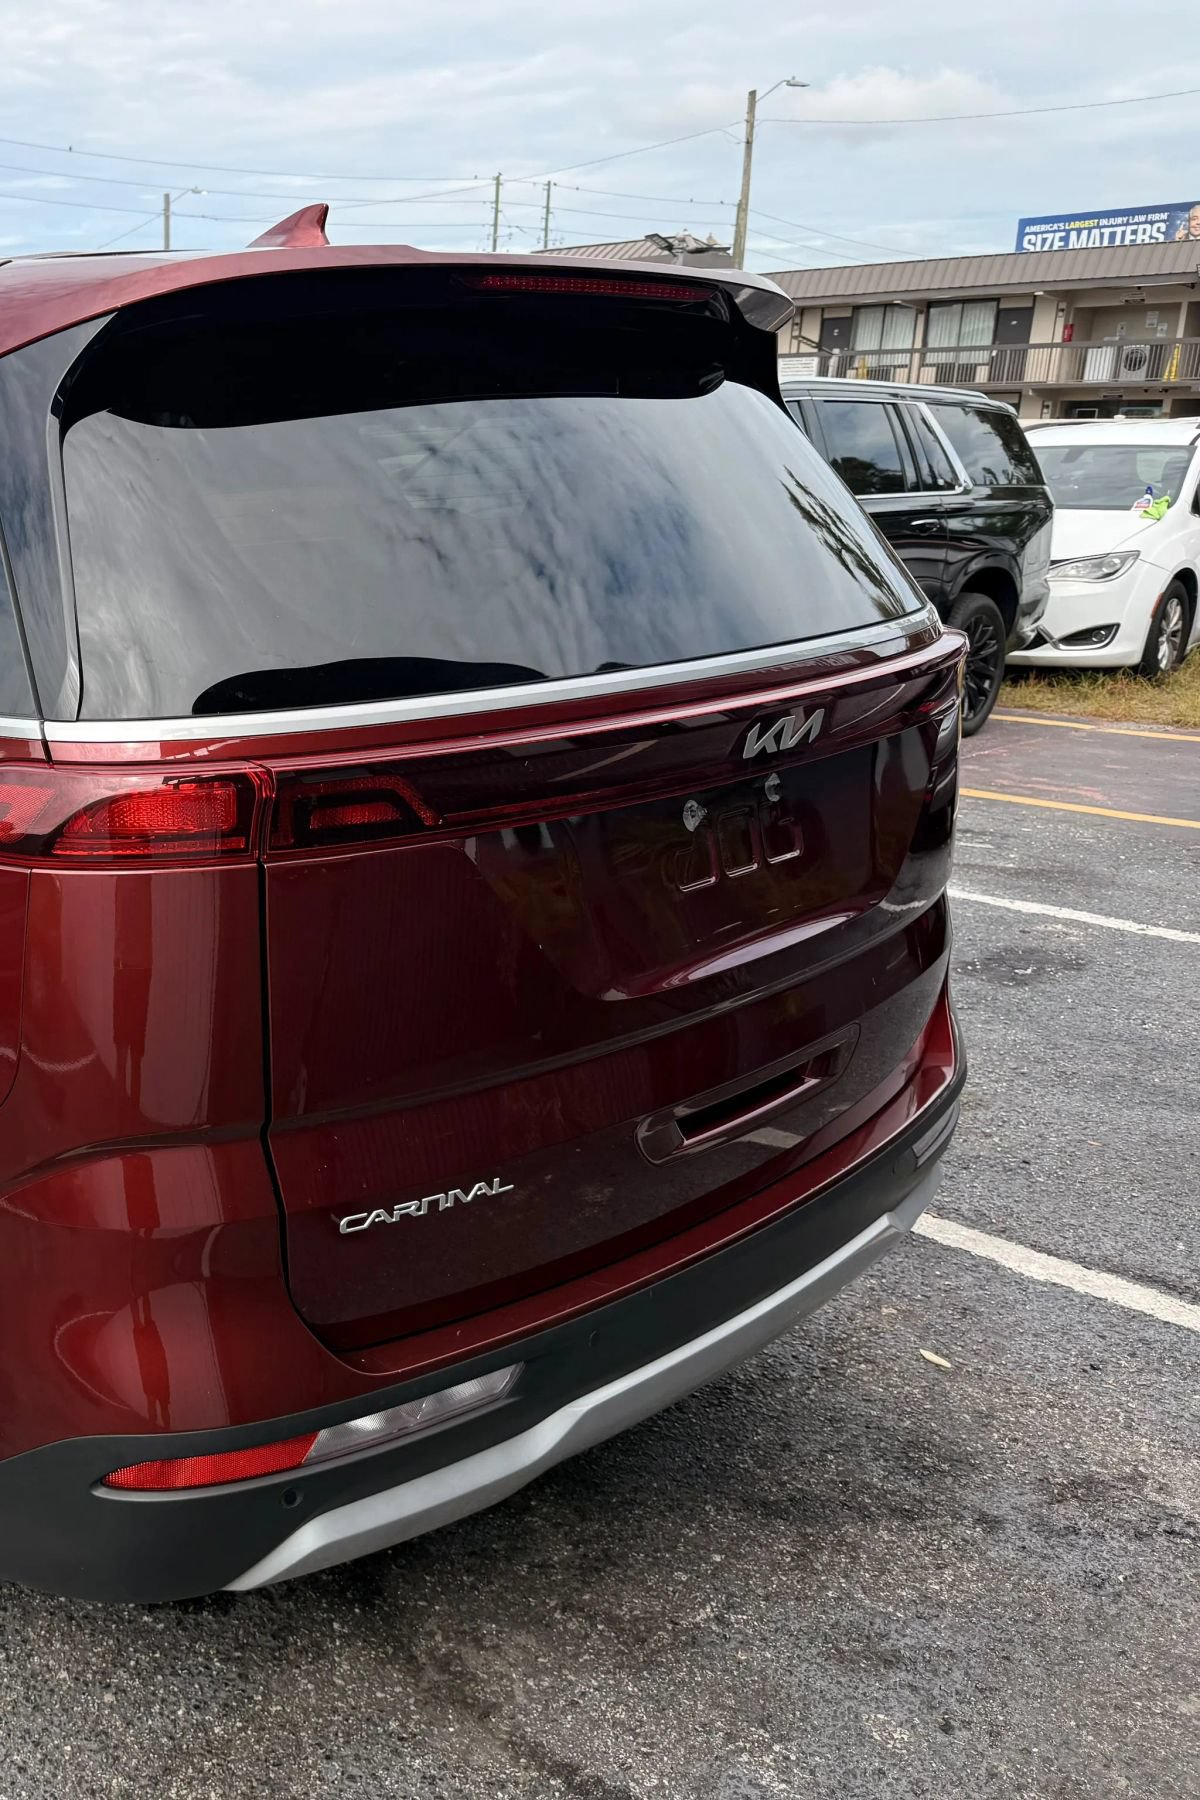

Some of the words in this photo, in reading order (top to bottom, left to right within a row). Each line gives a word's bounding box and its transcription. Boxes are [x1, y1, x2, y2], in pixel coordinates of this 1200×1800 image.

[1022, 231, 1066, 251] SIZE
[1068, 222, 1167, 248] MATTERS
[1024, 223, 1065, 233] AMERICA'S
[1065, 219, 1099, 229] LARGEST
[1099, 216, 1129, 226] INJURY
[1129, 214, 1147, 223] LAW
[1147, 212, 1168, 221] FIRM
[742, 708, 825, 759] KIA
[339, 1177, 515, 1234] CARNIVAL
